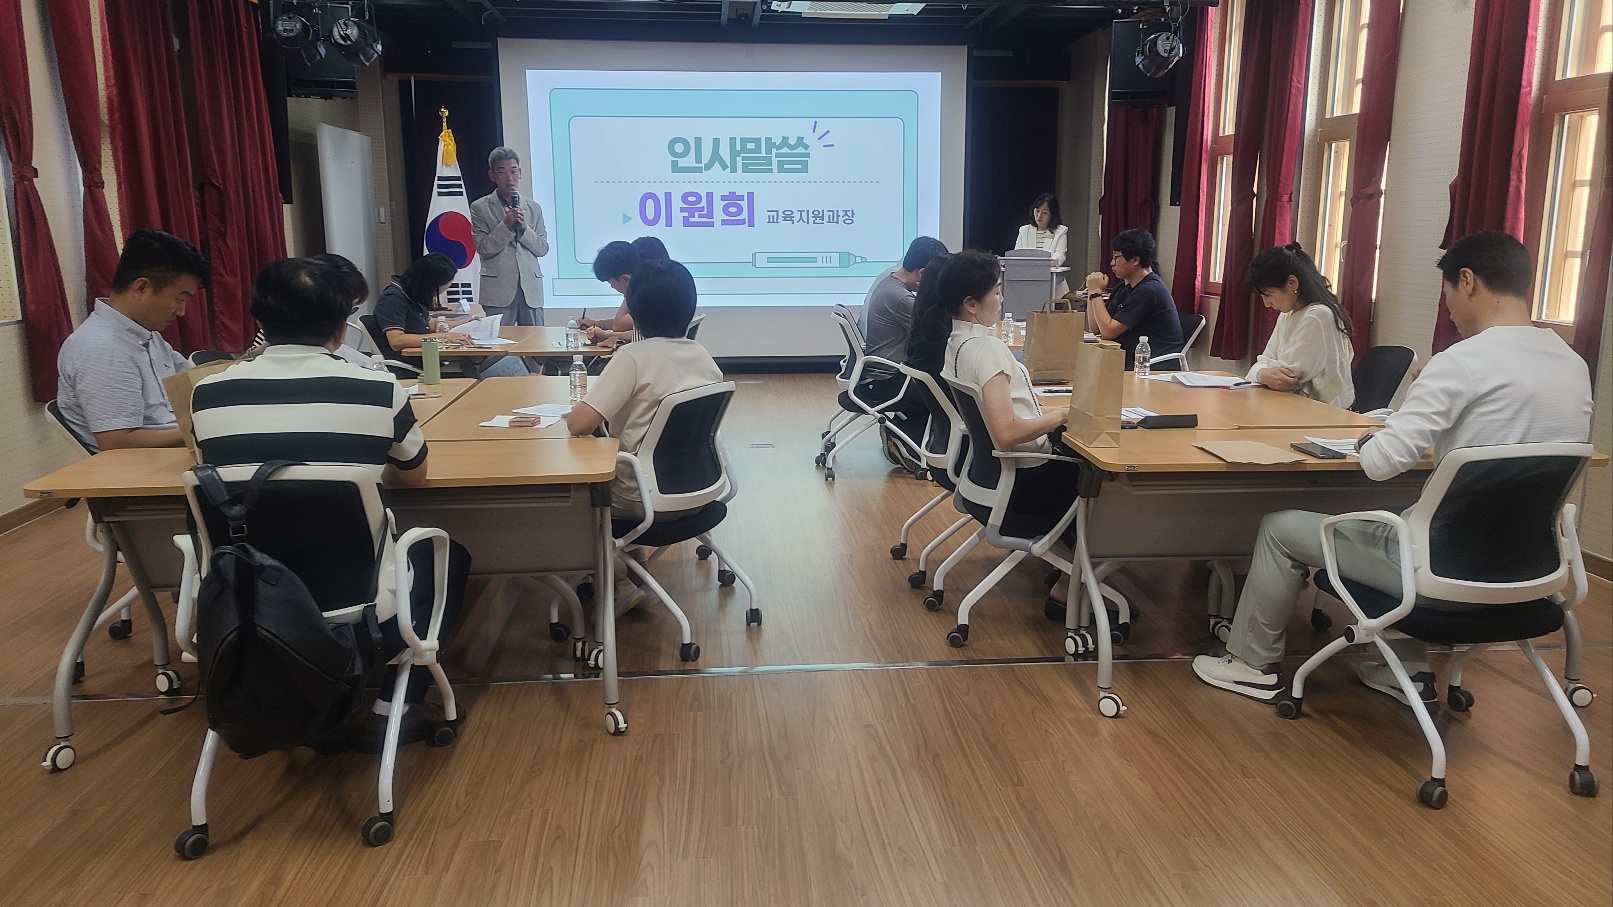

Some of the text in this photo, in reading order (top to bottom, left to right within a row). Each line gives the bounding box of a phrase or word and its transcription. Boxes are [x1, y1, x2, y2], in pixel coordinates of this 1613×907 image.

[667, 135, 811, 174] 인사말씀
[638, 191, 856, 228] 이원희 교육지원과장
